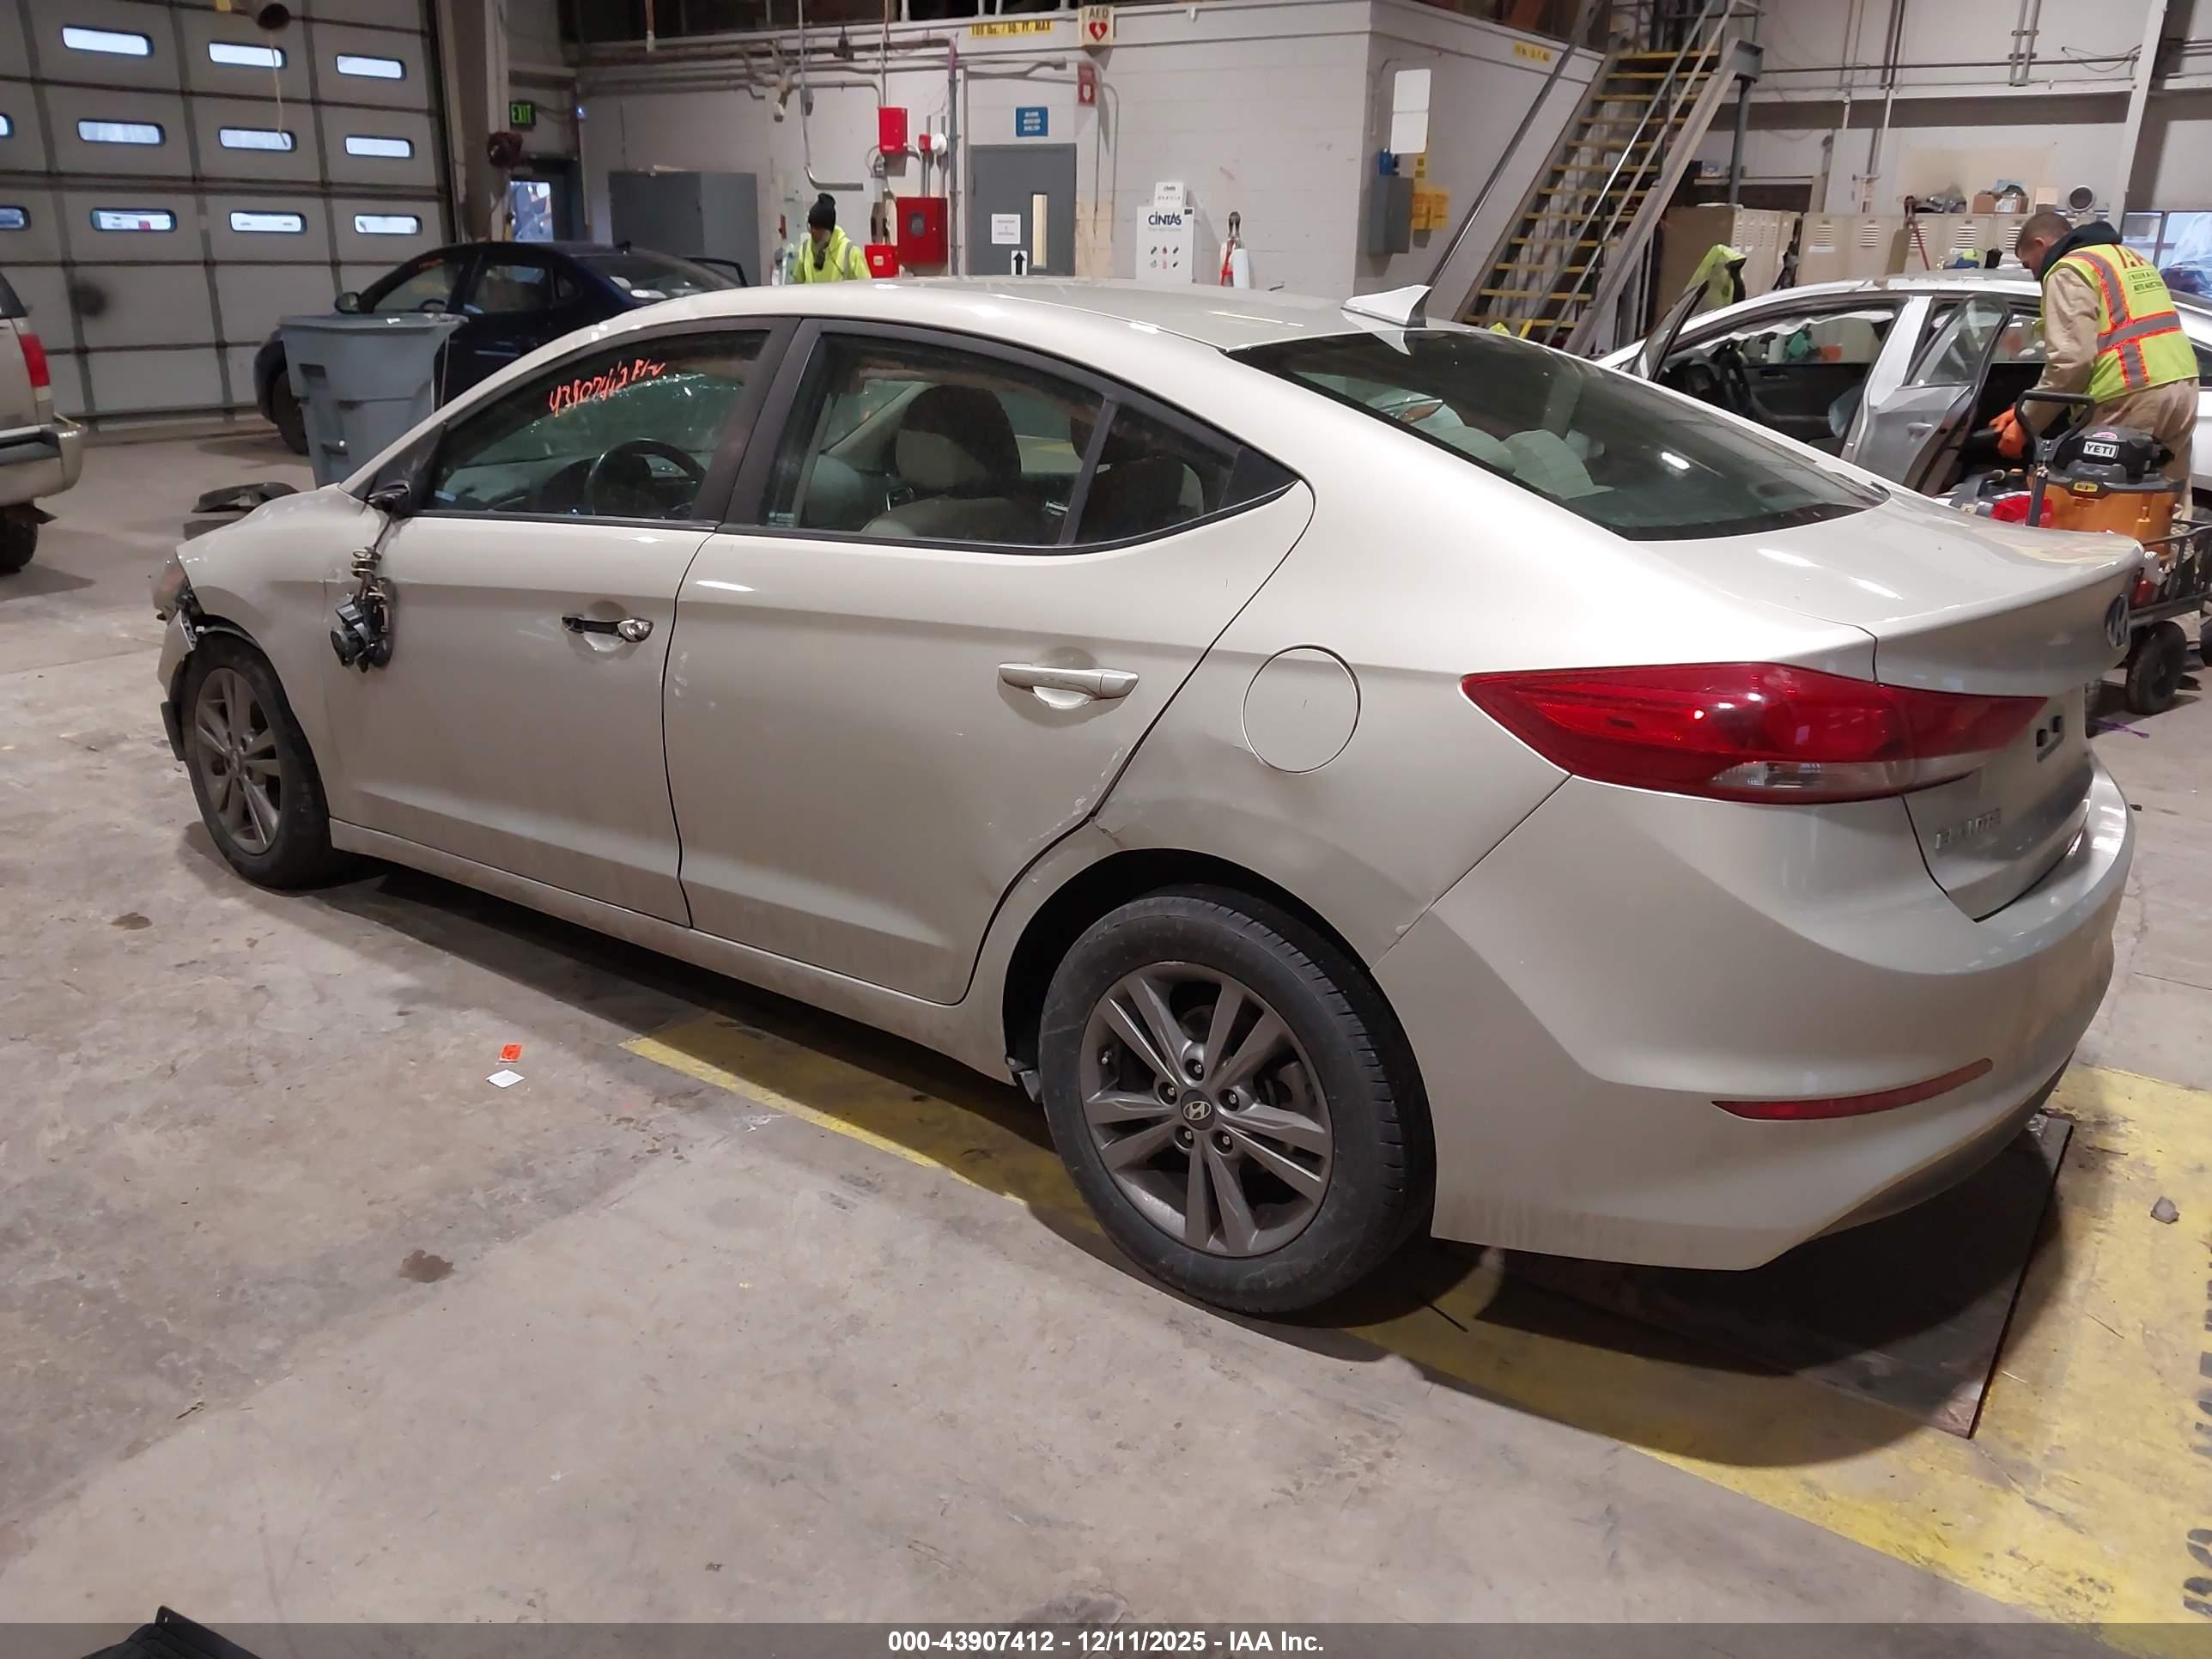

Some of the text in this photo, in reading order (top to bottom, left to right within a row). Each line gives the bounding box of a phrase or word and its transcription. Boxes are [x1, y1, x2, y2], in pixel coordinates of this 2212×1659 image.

[1089, 8, 1109, 18] AED
[511, 103, 532, 125] EXIT
[1148, 211, 1182, 225] CINTAS
[2087, 443, 2113, 456] YETI
